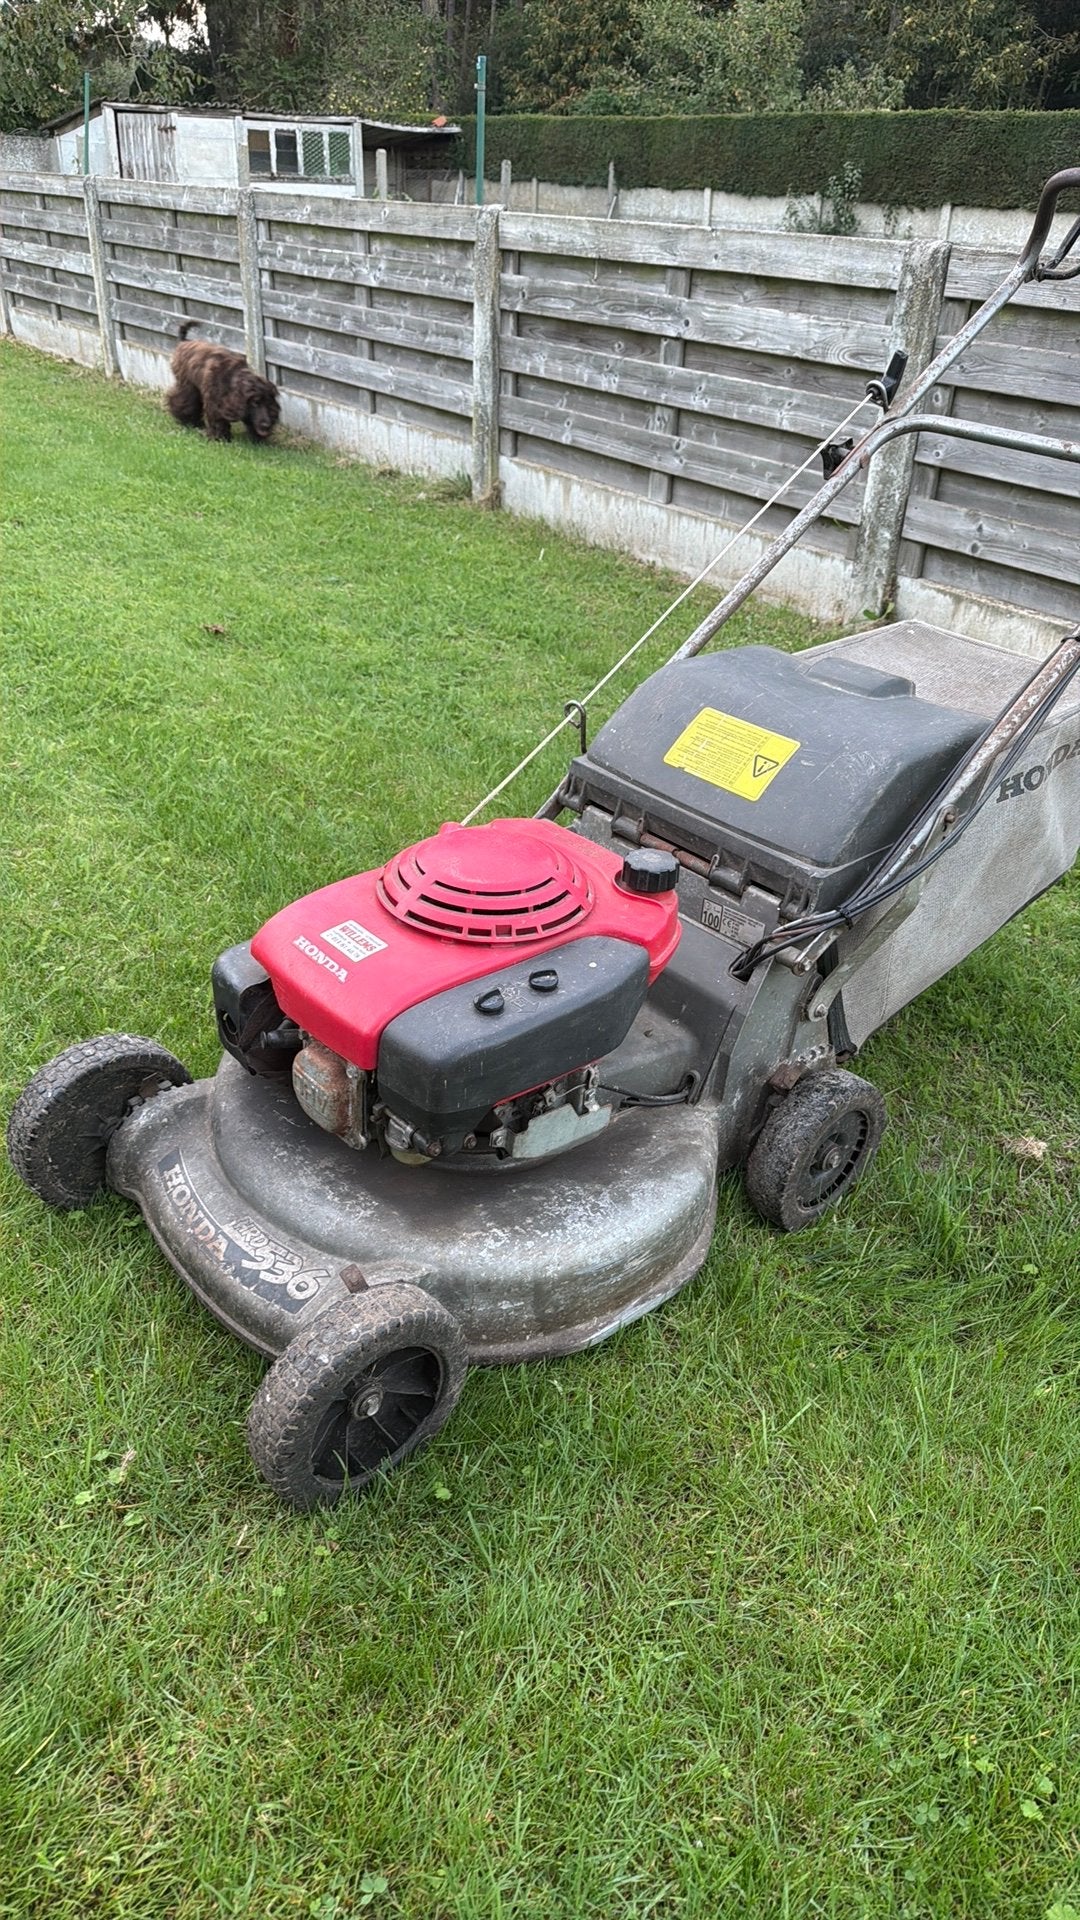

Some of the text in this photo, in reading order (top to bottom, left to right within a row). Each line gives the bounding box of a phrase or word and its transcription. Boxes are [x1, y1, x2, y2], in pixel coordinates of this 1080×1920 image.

[339, 925, 377, 951] WILLEMS
[703, 910, 720, 928] 100
[292, 935, 349, 983] HONDA
[164, 1163, 230, 1261] HONDA
[241, 1238, 332, 1301] 536
